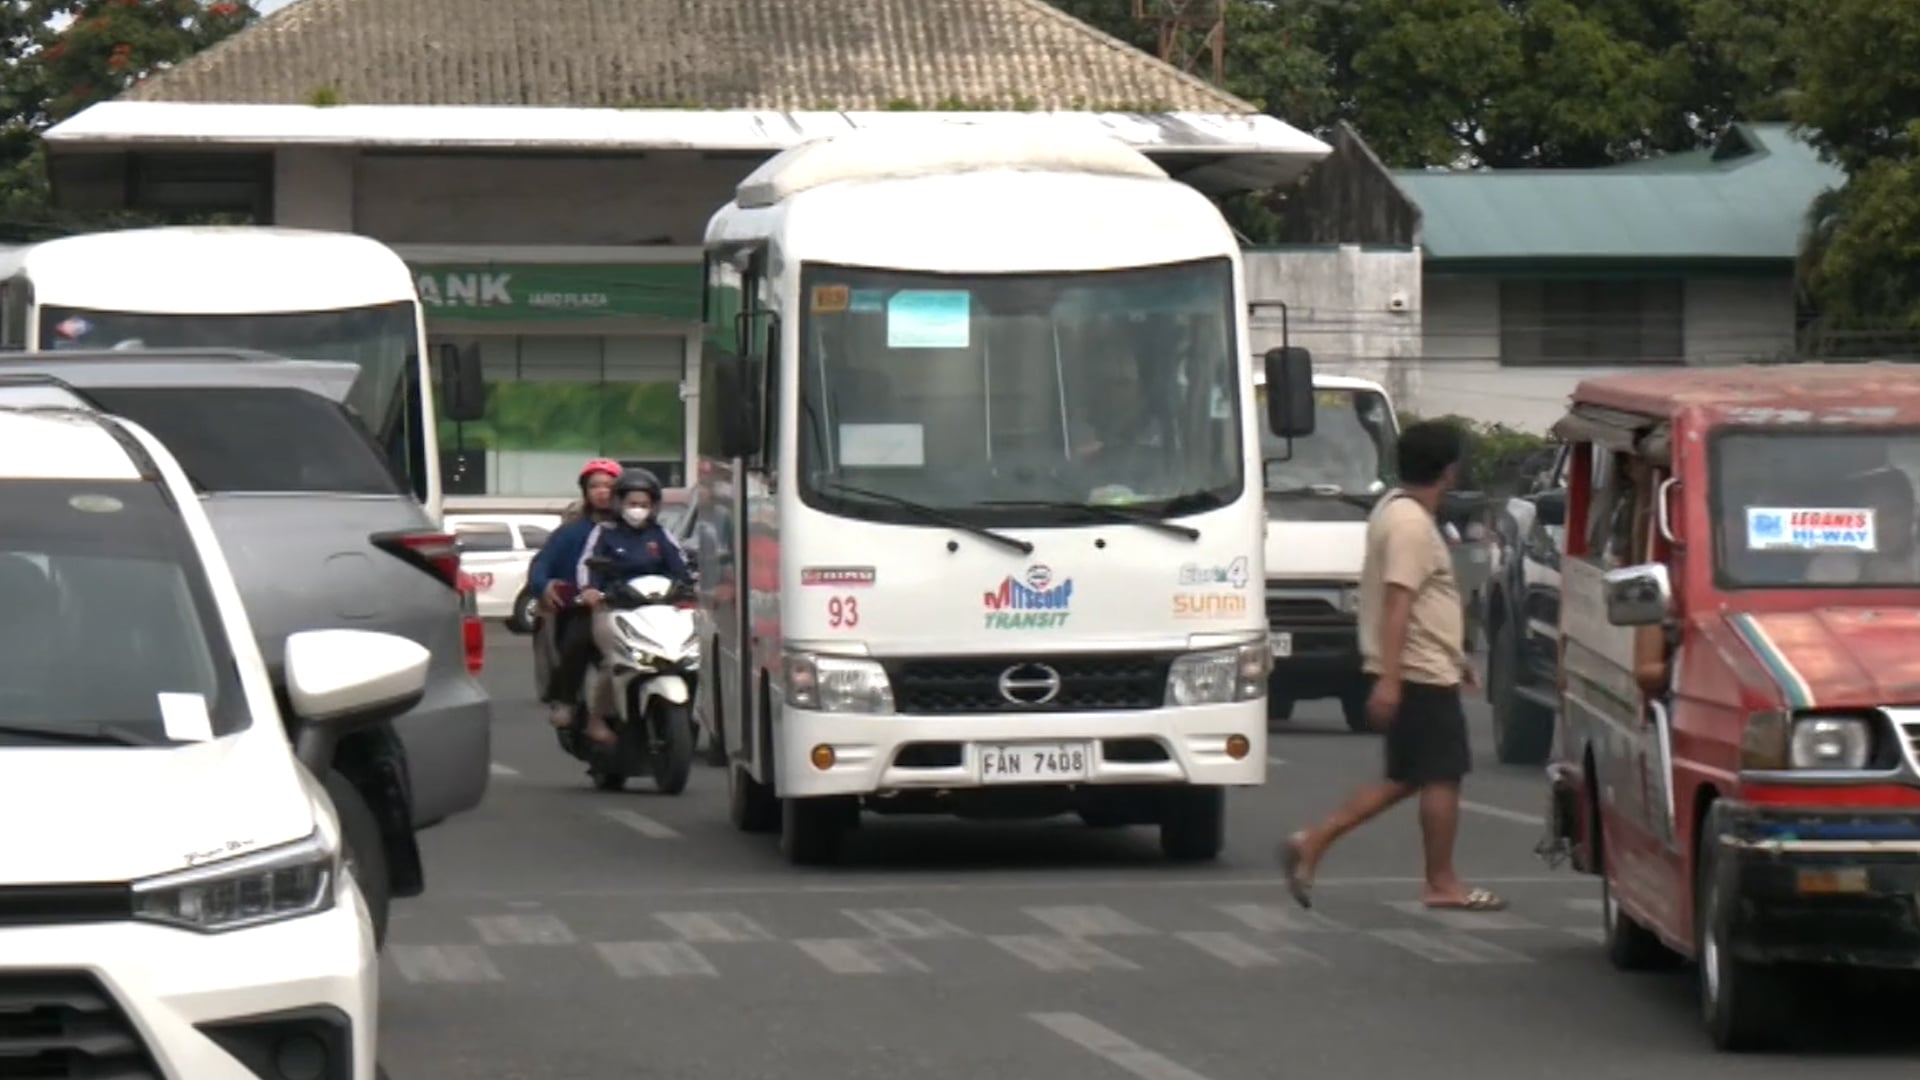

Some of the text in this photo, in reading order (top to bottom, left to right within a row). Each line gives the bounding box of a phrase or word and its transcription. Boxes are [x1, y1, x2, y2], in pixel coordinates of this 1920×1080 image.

[1792, 530, 1868, 542] HI-WAY
[828, 596, 859, 626] 93
[983, 611, 1070, 630] TRANSIT
[984, 753, 1021, 774] FAN
